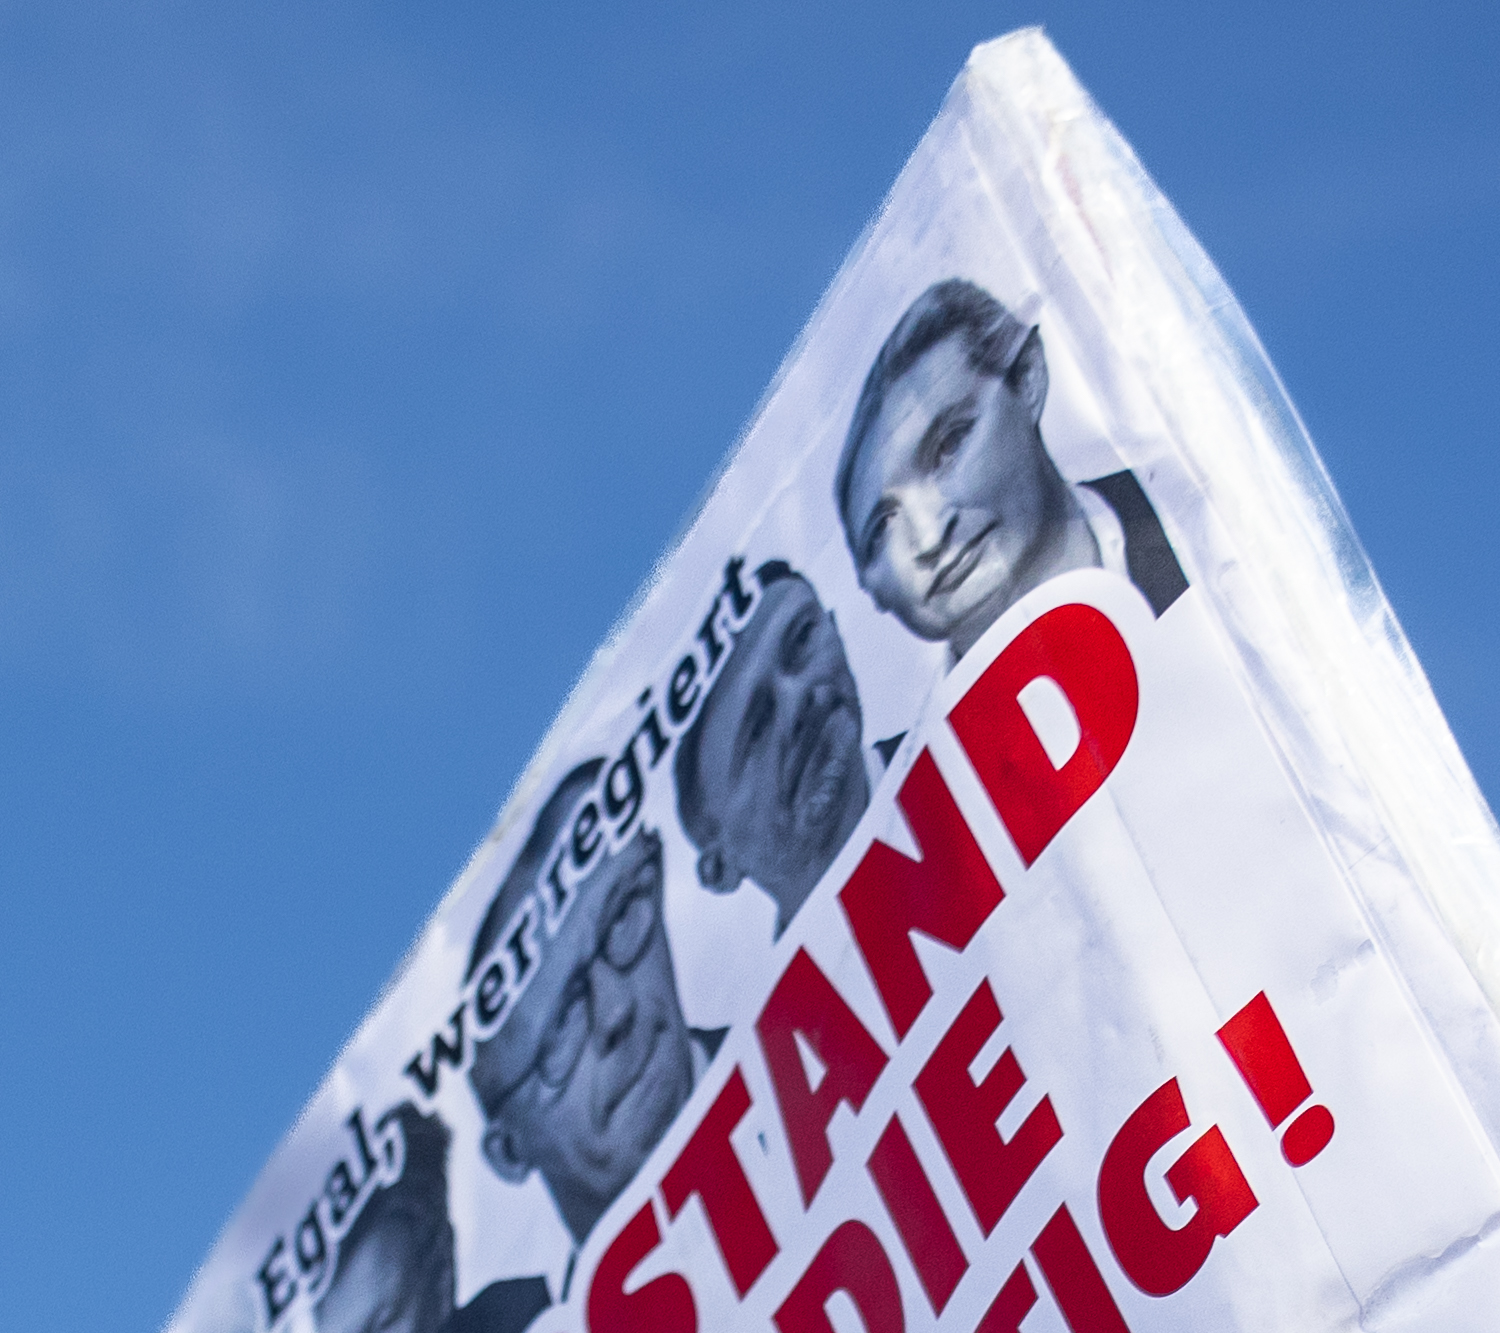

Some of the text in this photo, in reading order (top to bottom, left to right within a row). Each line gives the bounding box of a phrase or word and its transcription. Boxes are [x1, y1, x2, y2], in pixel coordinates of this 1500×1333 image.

[254, 557, 757, 1330] Egal, wer regiert
